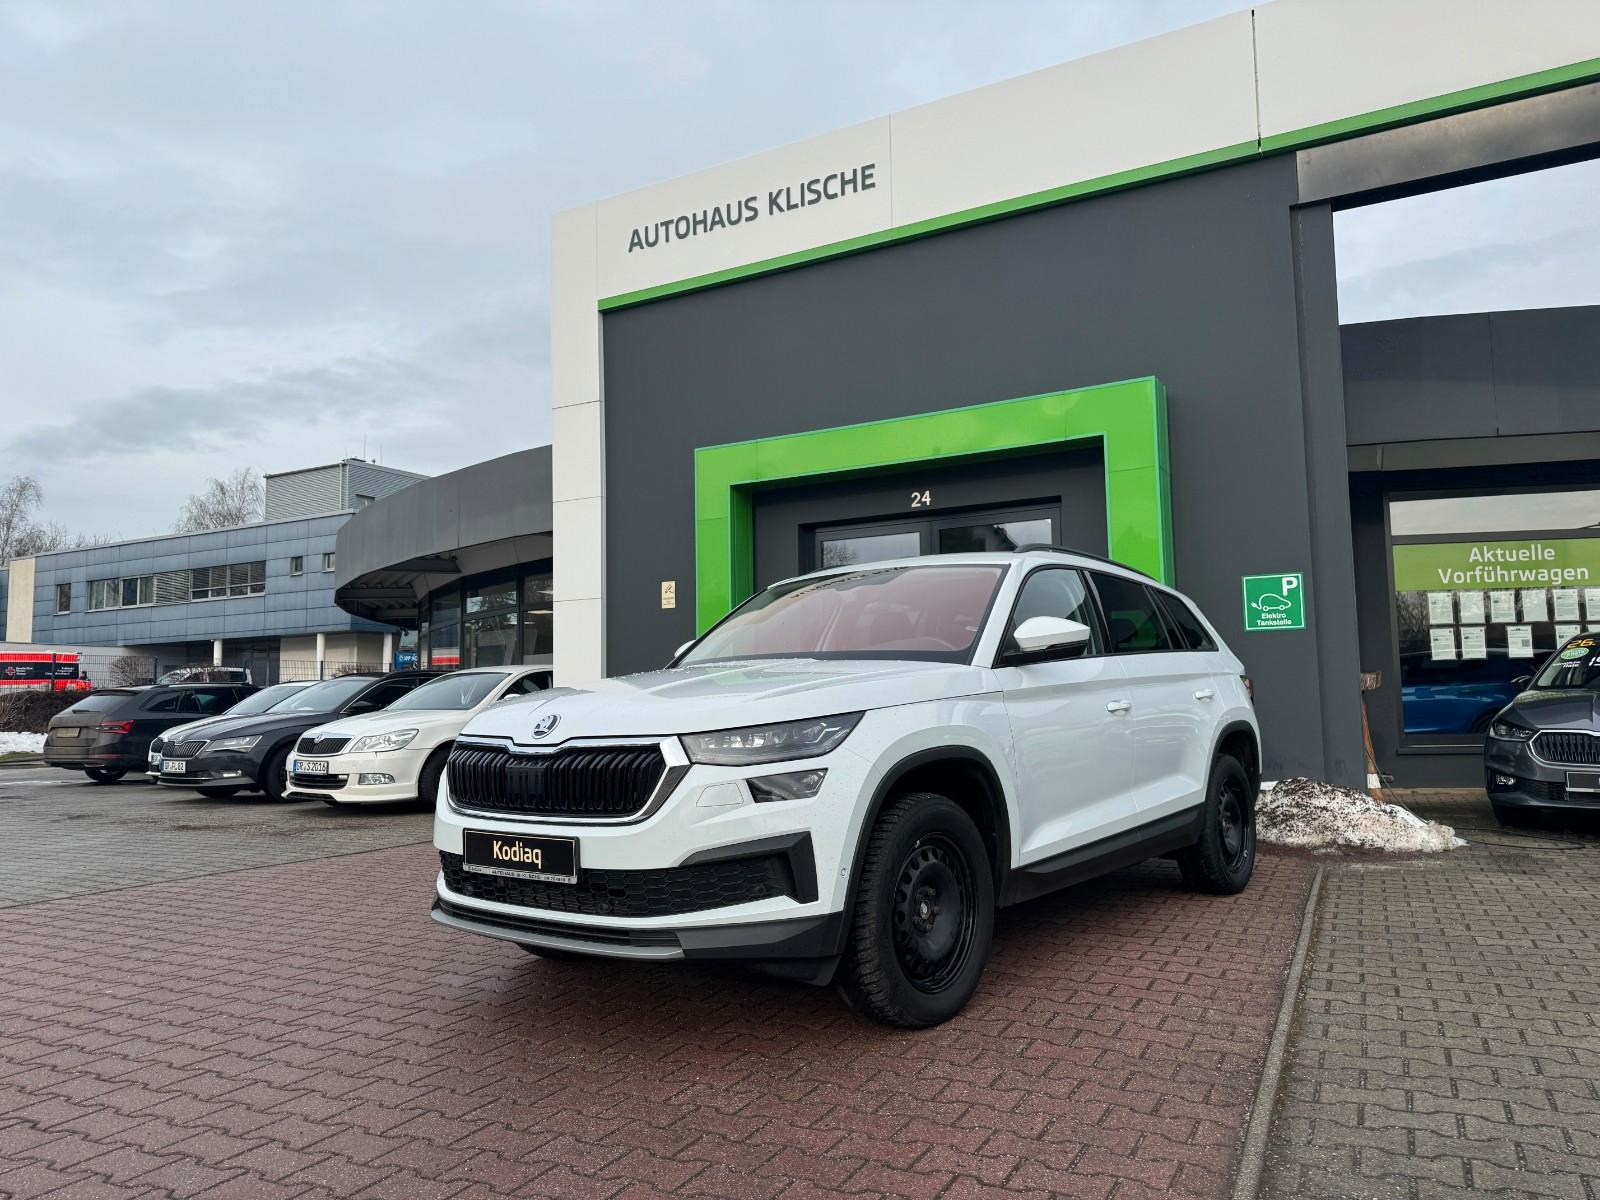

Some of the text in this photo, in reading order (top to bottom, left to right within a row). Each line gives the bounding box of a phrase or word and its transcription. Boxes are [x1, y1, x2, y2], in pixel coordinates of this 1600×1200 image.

[628, 162, 877, 253] AUTOHAUS KLISCHE
[911, 490, 932, 508] 24
[1468, 543, 1556, 563] Aktuelle
[1437, 565, 1590, 585] Vorführwagen
[1281, 576, 1298, 596] P
[493, 840, 542, 870] Kodiaq
